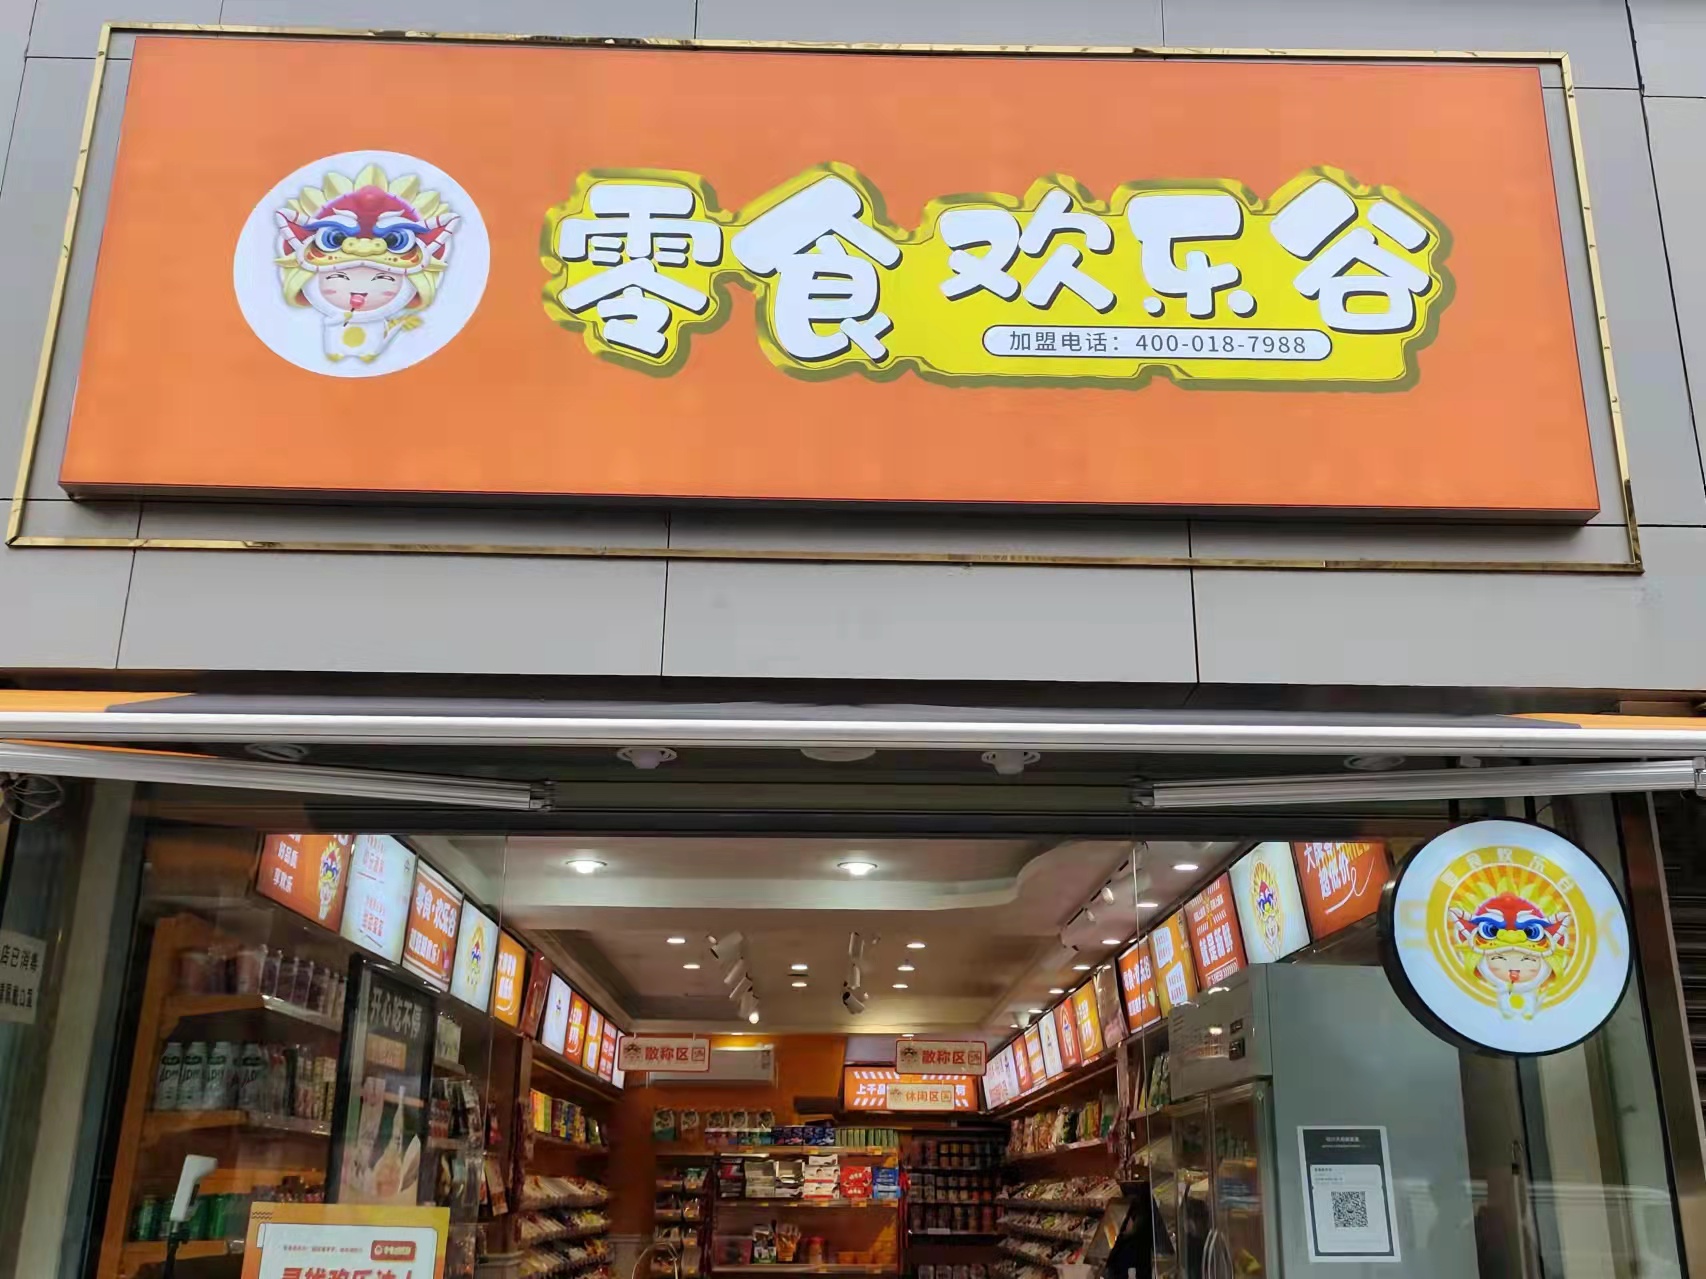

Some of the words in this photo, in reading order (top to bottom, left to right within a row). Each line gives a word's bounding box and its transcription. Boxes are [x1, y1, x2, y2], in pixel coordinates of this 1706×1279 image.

[557, 175, 1434, 362] 零食欢乐谷
